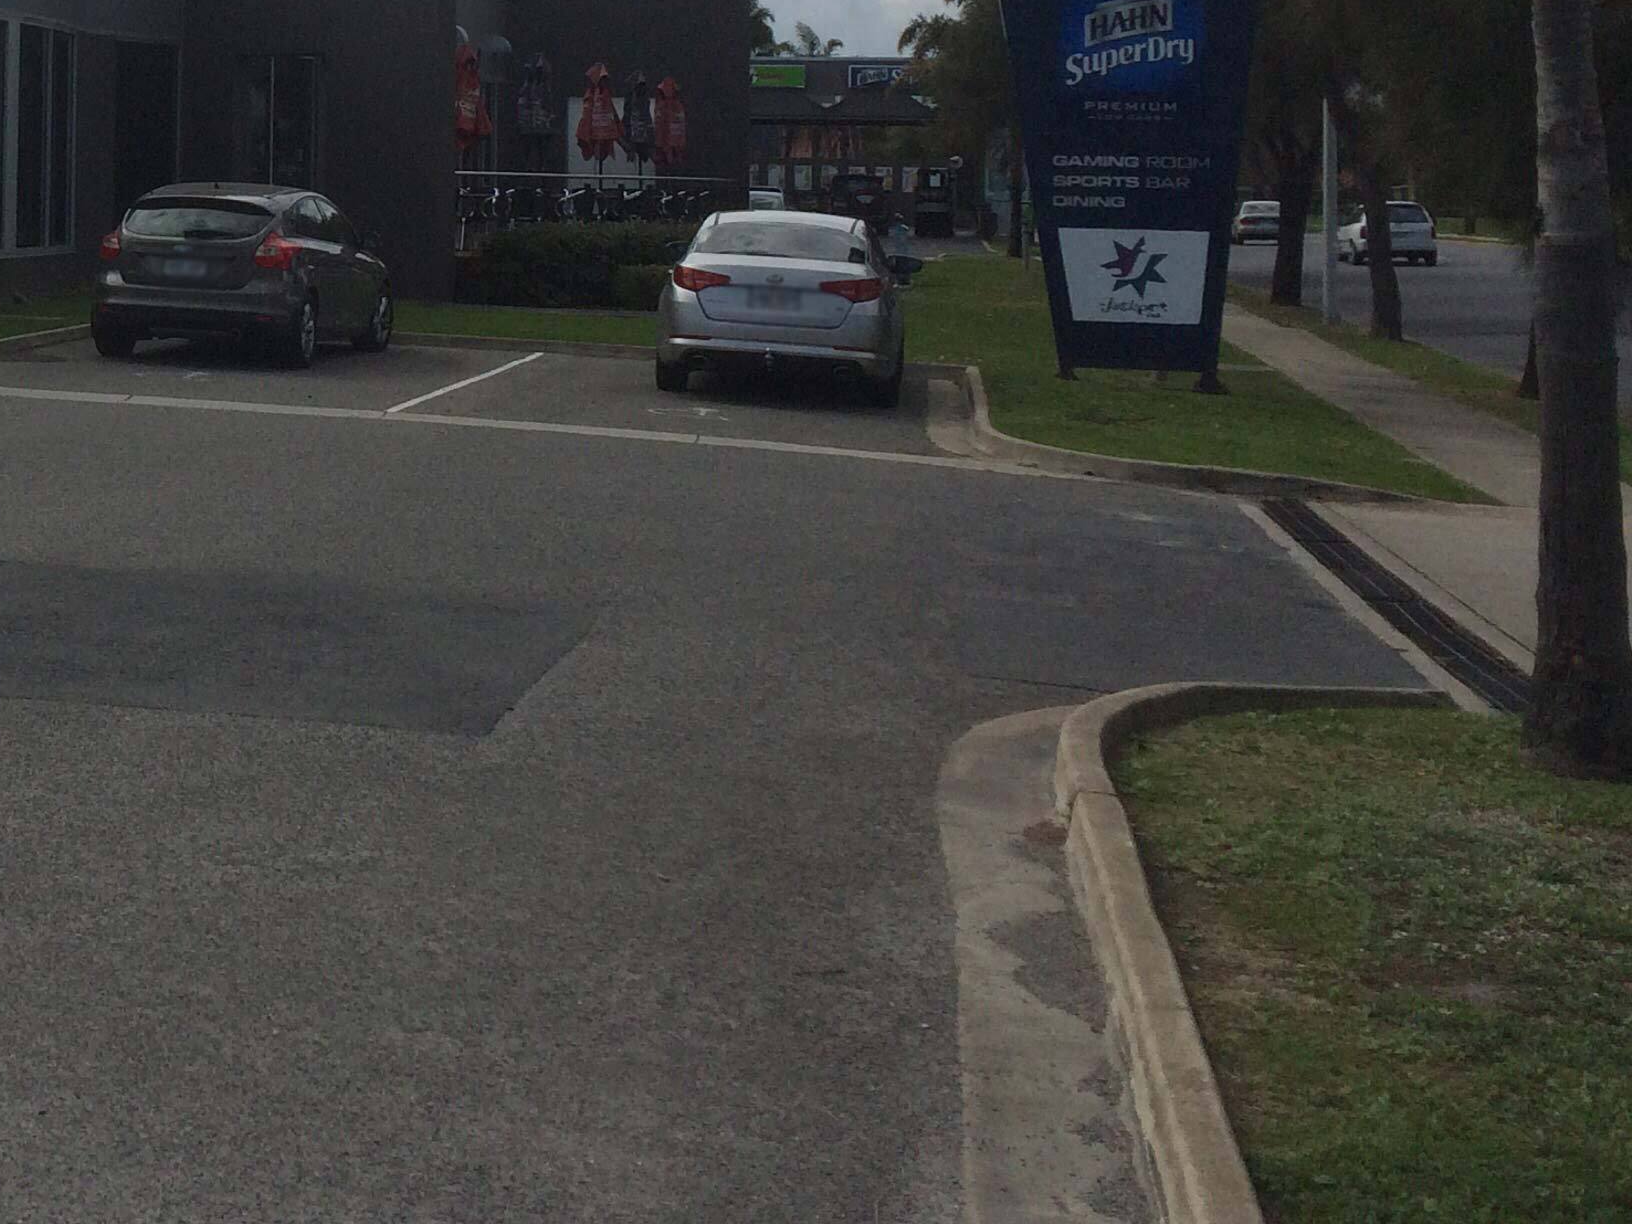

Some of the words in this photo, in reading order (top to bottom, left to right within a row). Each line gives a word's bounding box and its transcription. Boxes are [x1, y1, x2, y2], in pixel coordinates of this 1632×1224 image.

[1089, 3, 1169, 41] HAHN
[1065, 36, 1195, 85] SuperDry
[1083, 101, 1177, 112] PREMIUM
[1052, 155, 1139, 169] GAMING
[1145, 155, 1211, 169] ROOM
[1052, 175, 1140, 189] SPORTS
[1145, 176, 1192, 190] BAR
[1052, 195, 1126, 208] DINING
